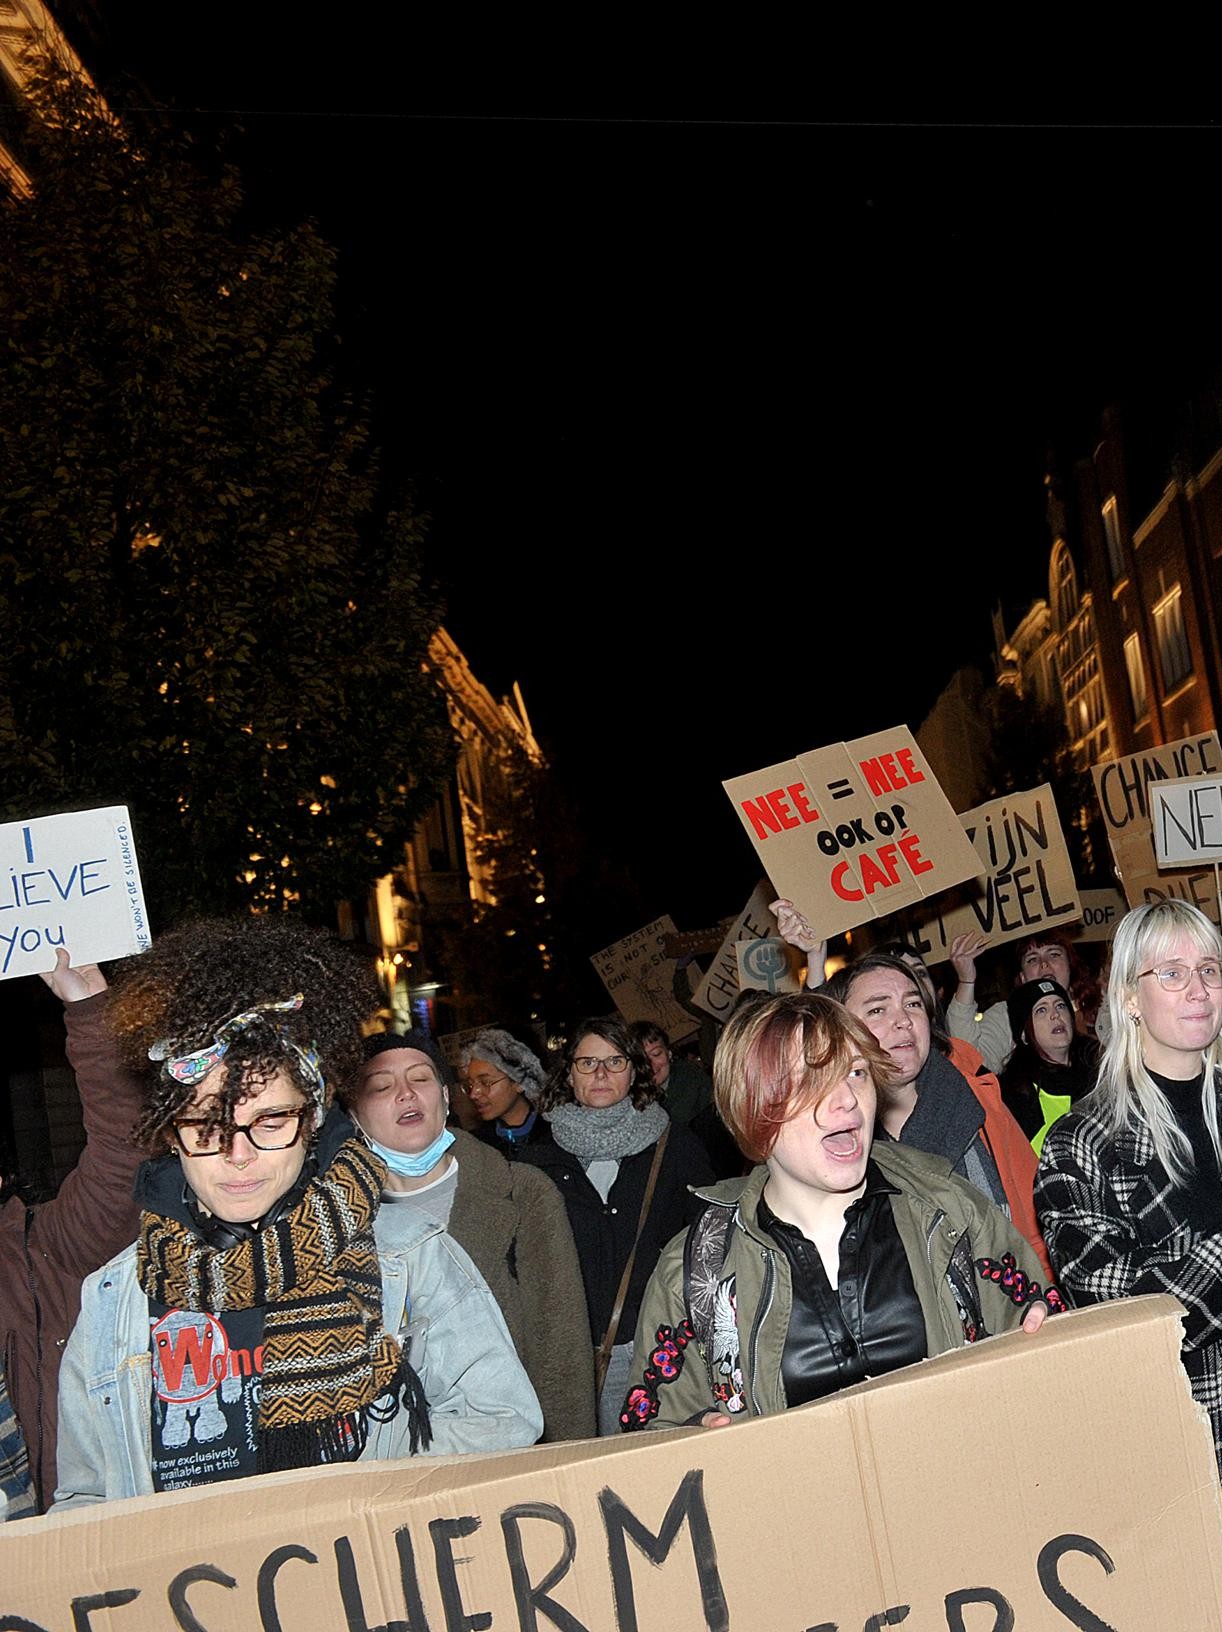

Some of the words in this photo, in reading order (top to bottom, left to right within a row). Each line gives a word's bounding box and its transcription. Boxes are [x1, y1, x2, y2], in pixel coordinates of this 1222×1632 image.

[741, 783, 820, 840] NEE
[859, 748, 926, 797] NEE
[22, 826, 34, 863] I
[817, 818, 875, 856] OOK
[874, 804, 908, 836] OP
[830, 829, 934, 902] CAFÉ
[970, 859, 1075, 932] VEEL
[160, 1465, 202, 1481] available
[204, 1462, 213, 1473] in
[215, 1458, 240, 1471] this
[177, 1446, 238, 1466] exclusively
